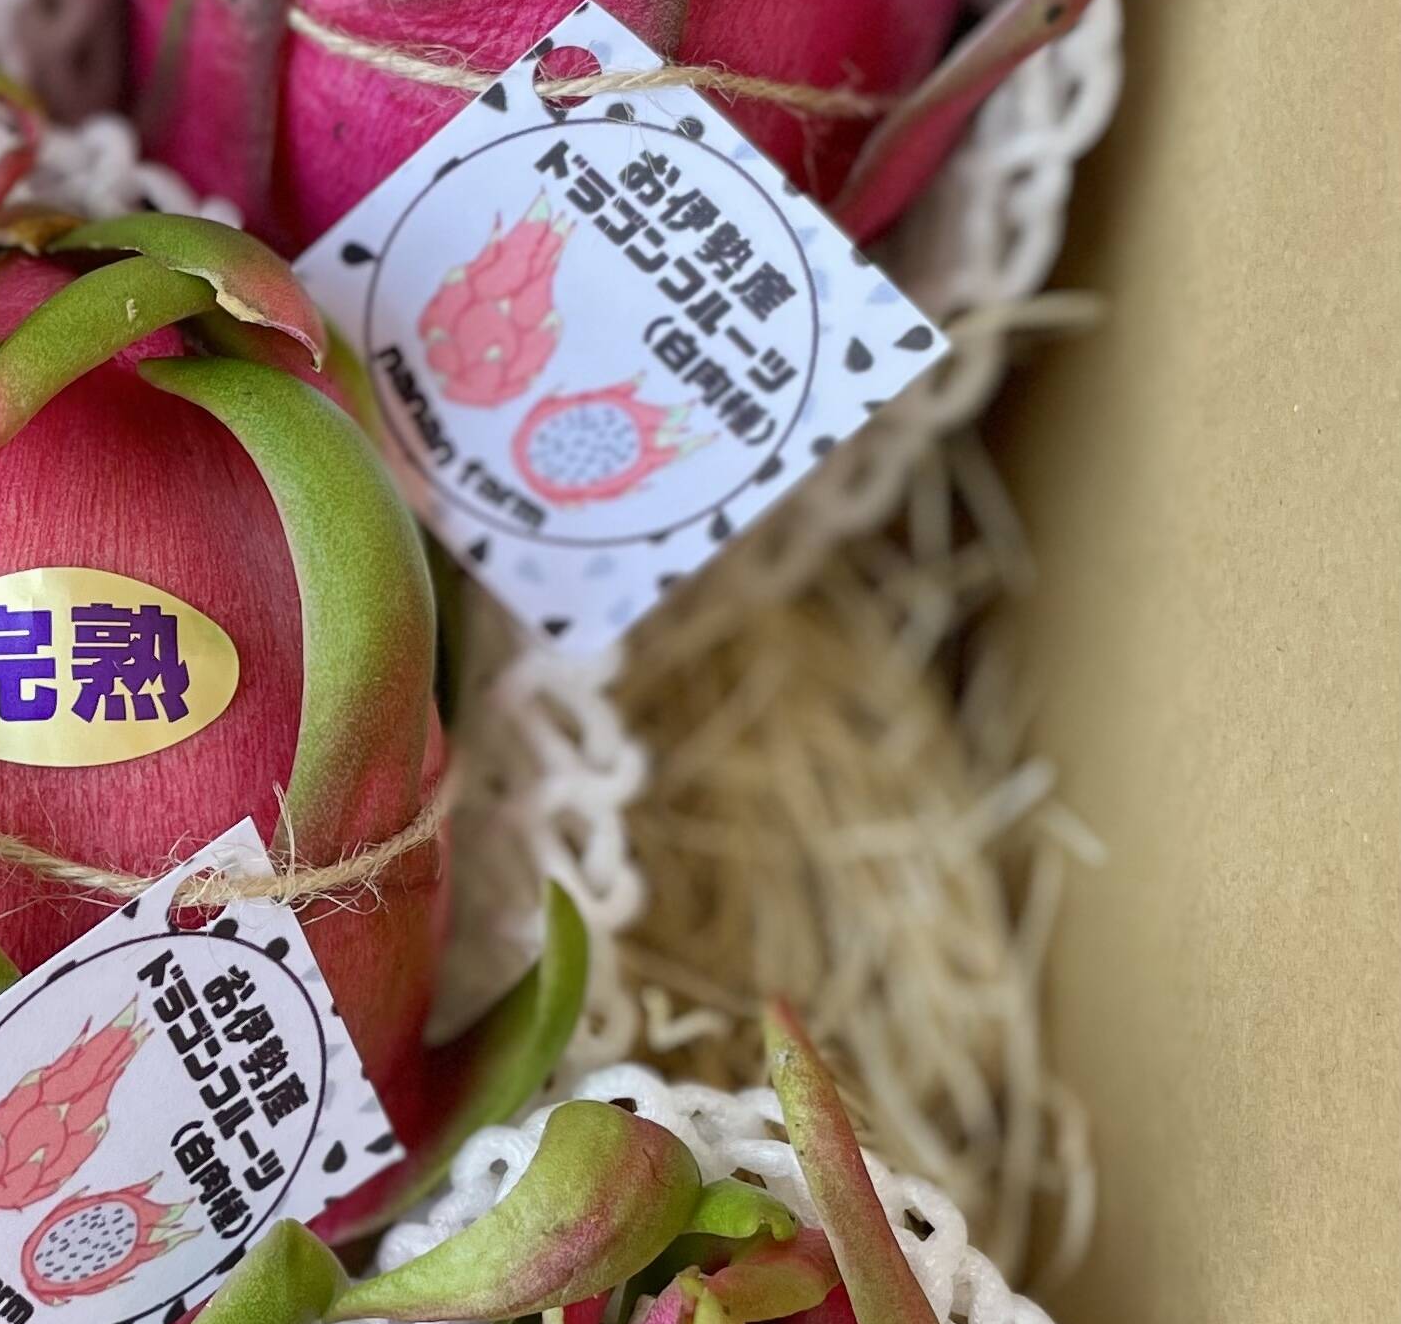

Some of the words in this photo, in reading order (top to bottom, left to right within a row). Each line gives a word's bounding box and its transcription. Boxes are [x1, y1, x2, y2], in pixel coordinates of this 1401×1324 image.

[534, 140, 798, 394] ドラゴンフルーツ
[618, 150, 797, 322] お伊勢産
[377, 344, 456, 466] nanan
[456, 459, 549, 530] farm
[137, 949, 286, 1191] ドラゴンフルーツ
[203, 964, 309, 1128] お伊勢産
